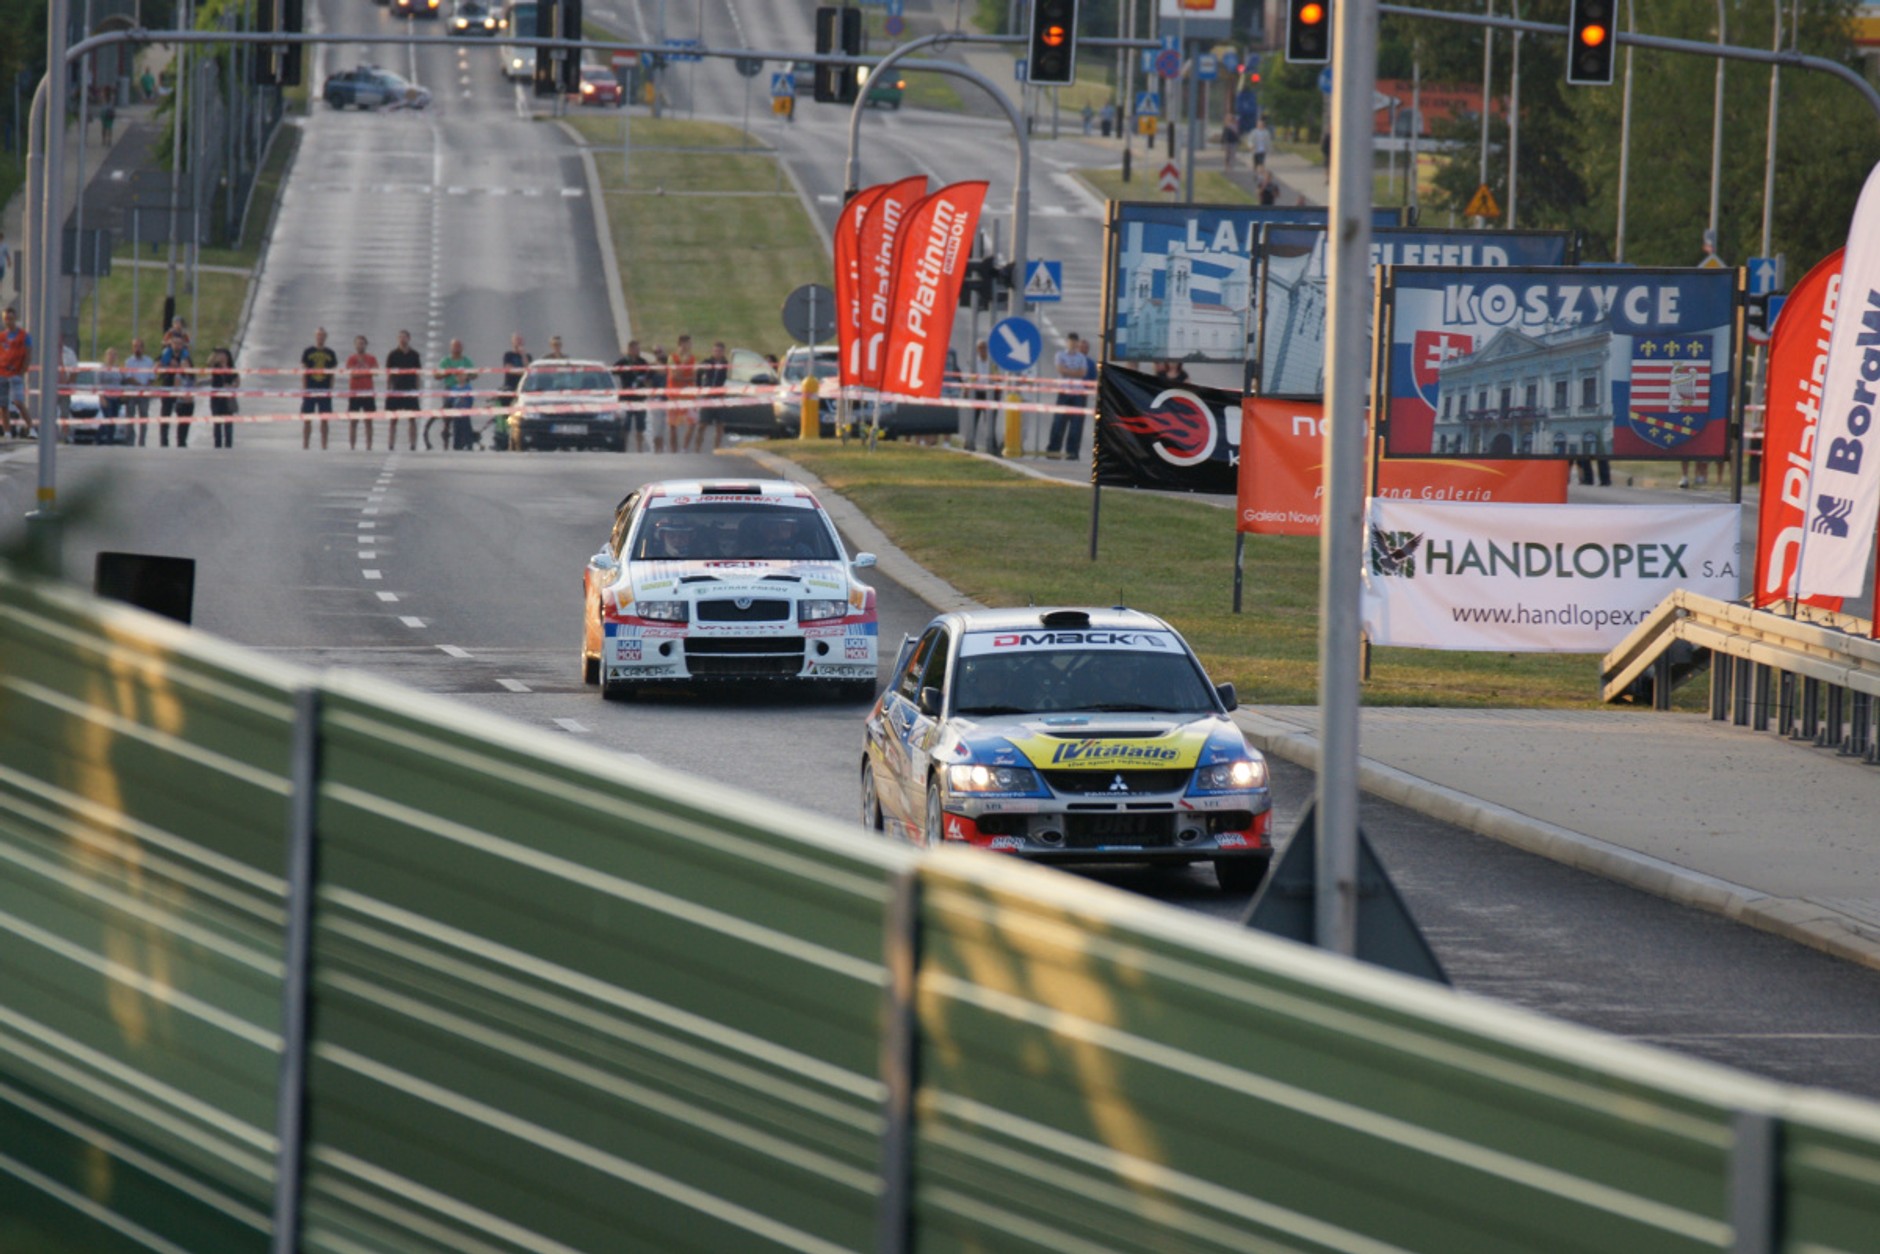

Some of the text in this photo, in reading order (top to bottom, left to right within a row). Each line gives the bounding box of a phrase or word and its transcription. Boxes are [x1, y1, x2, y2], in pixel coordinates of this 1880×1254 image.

[951, 211, 969, 236] OIL
[907, 199, 955, 338] Platinum
[1445, 284, 1681, 324] KOSZYCE
[1421, 486, 1492, 501] Galeria
[1243, 509, 1322, 525] Galeria Nowy
[1426, 539, 1739, 579] HANDLOPEX S.A.
[993, 633, 1130, 647] DMACK
